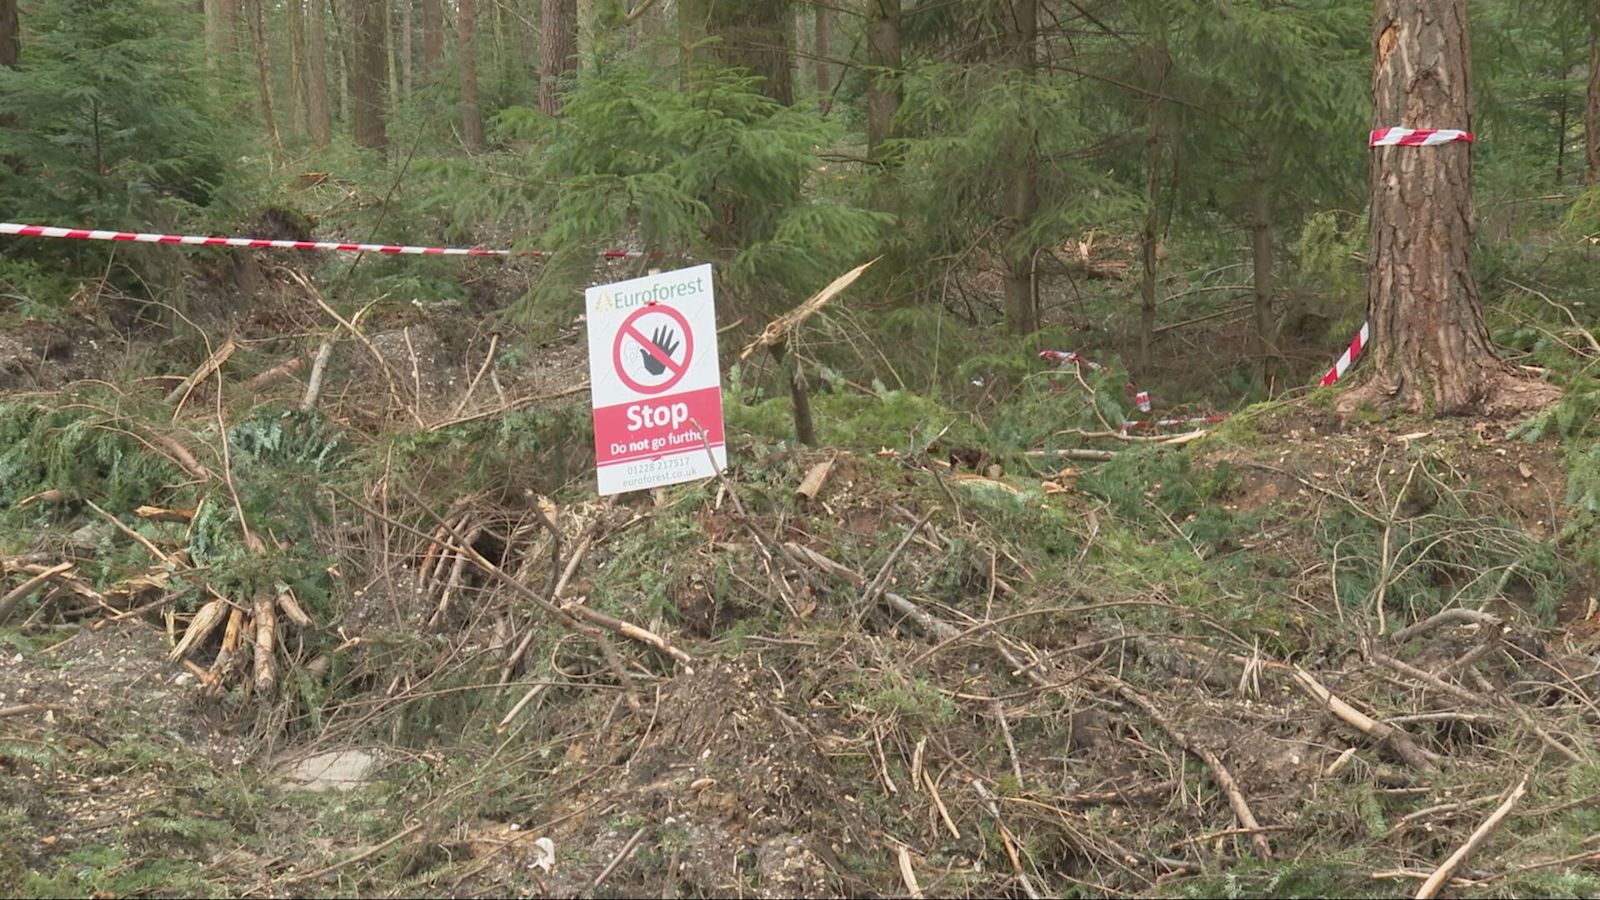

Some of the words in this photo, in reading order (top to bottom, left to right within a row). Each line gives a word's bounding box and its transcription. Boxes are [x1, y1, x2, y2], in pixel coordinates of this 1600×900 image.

[614, 277, 704, 309] Euroforest
[627, 402, 688, 431] Stop
[610, 443, 627, 455] Do
[629, 438, 649, 452] not
[651, 438, 666, 451] go
[627, 462, 655, 475] 01228
[657, 457, 690, 469] 217517
[622, 467, 697, 487] euroforest.co.uk
